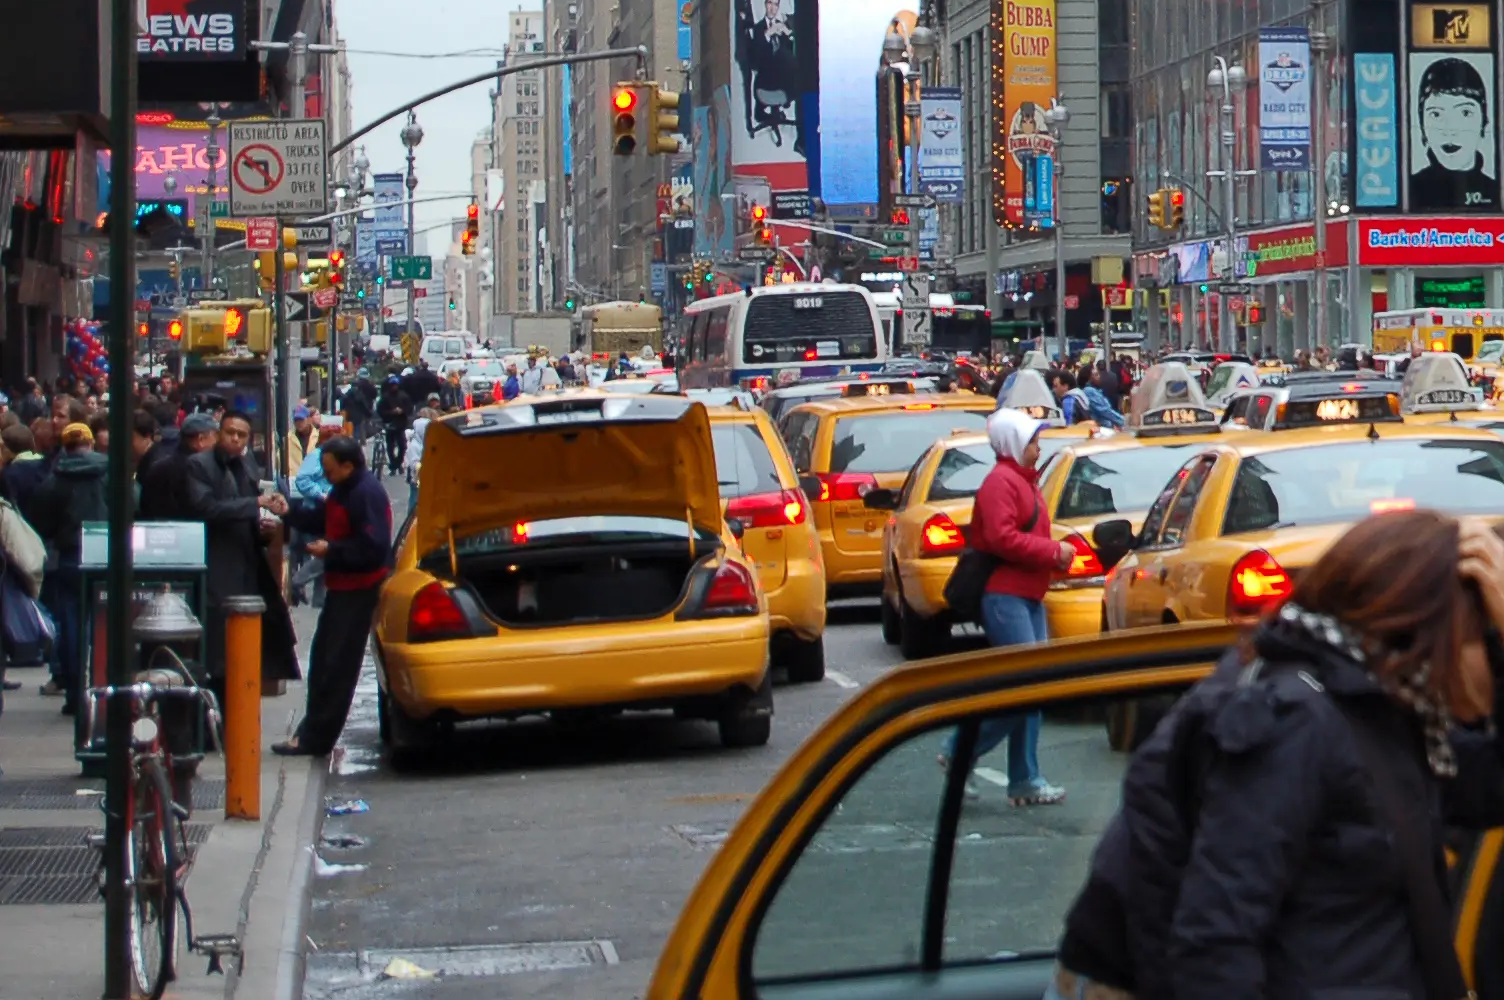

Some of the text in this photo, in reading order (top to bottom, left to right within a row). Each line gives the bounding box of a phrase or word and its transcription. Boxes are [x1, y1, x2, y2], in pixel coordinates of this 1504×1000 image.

[1007, 1, 1053, 28] BUBBA
[1432, 8, 1470, 44] MTV
[1010, 31, 1051, 57] GUMP
[233, 126, 320, 141] RESTRICTED AREA
[1361, 61, 1392, 196] PEACE
[285, 145, 320, 157] TRUCKS
[286, 163, 298, 176] 33
[291, 181, 316, 194] OVER
[301, 227, 323, 238] WAY
[1429, 228, 1494, 247] America
